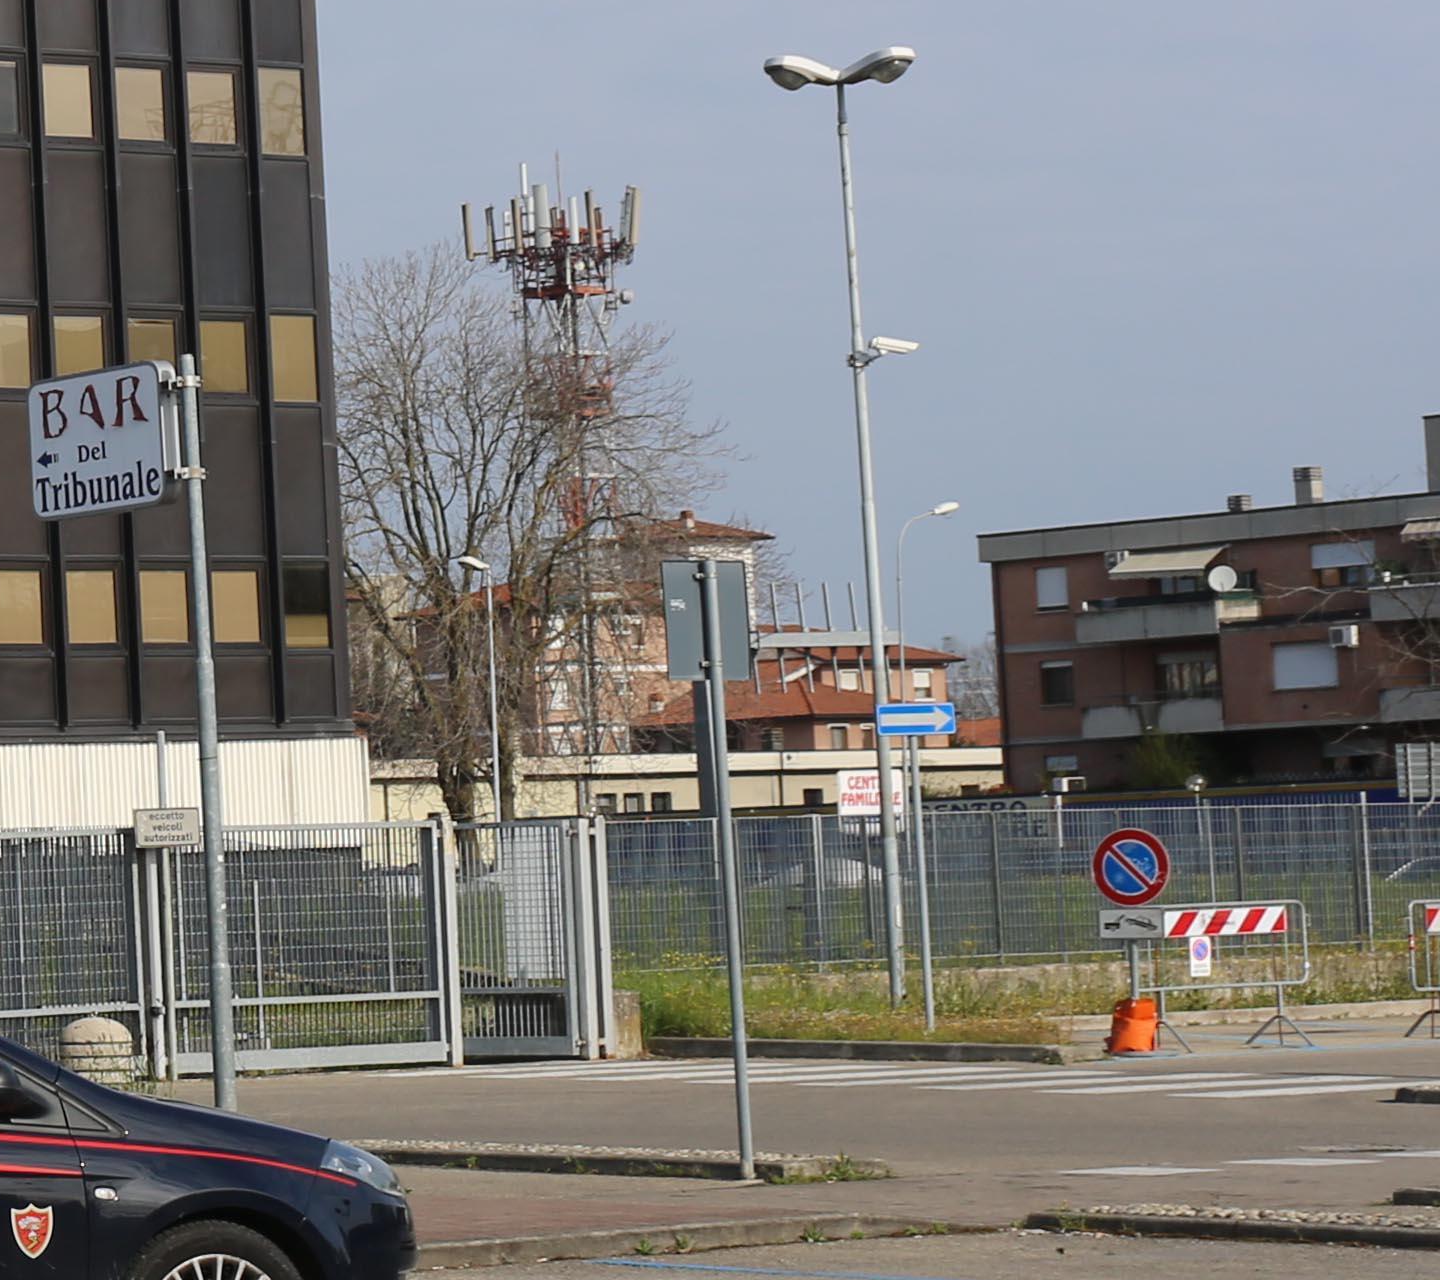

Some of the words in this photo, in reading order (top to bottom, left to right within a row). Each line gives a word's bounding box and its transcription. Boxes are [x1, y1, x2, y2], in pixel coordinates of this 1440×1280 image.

[38, 375, 149, 439] BAR
[77, 441, 107, 463] Del
[35, 460, 160, 513] Tribunale
[847, 775, 881, 789] CENT
[149, 811, 184, 820] eccetto
[152, 822, 183, 831] veicoli
[144, 831, 193, 842] autorizzati
